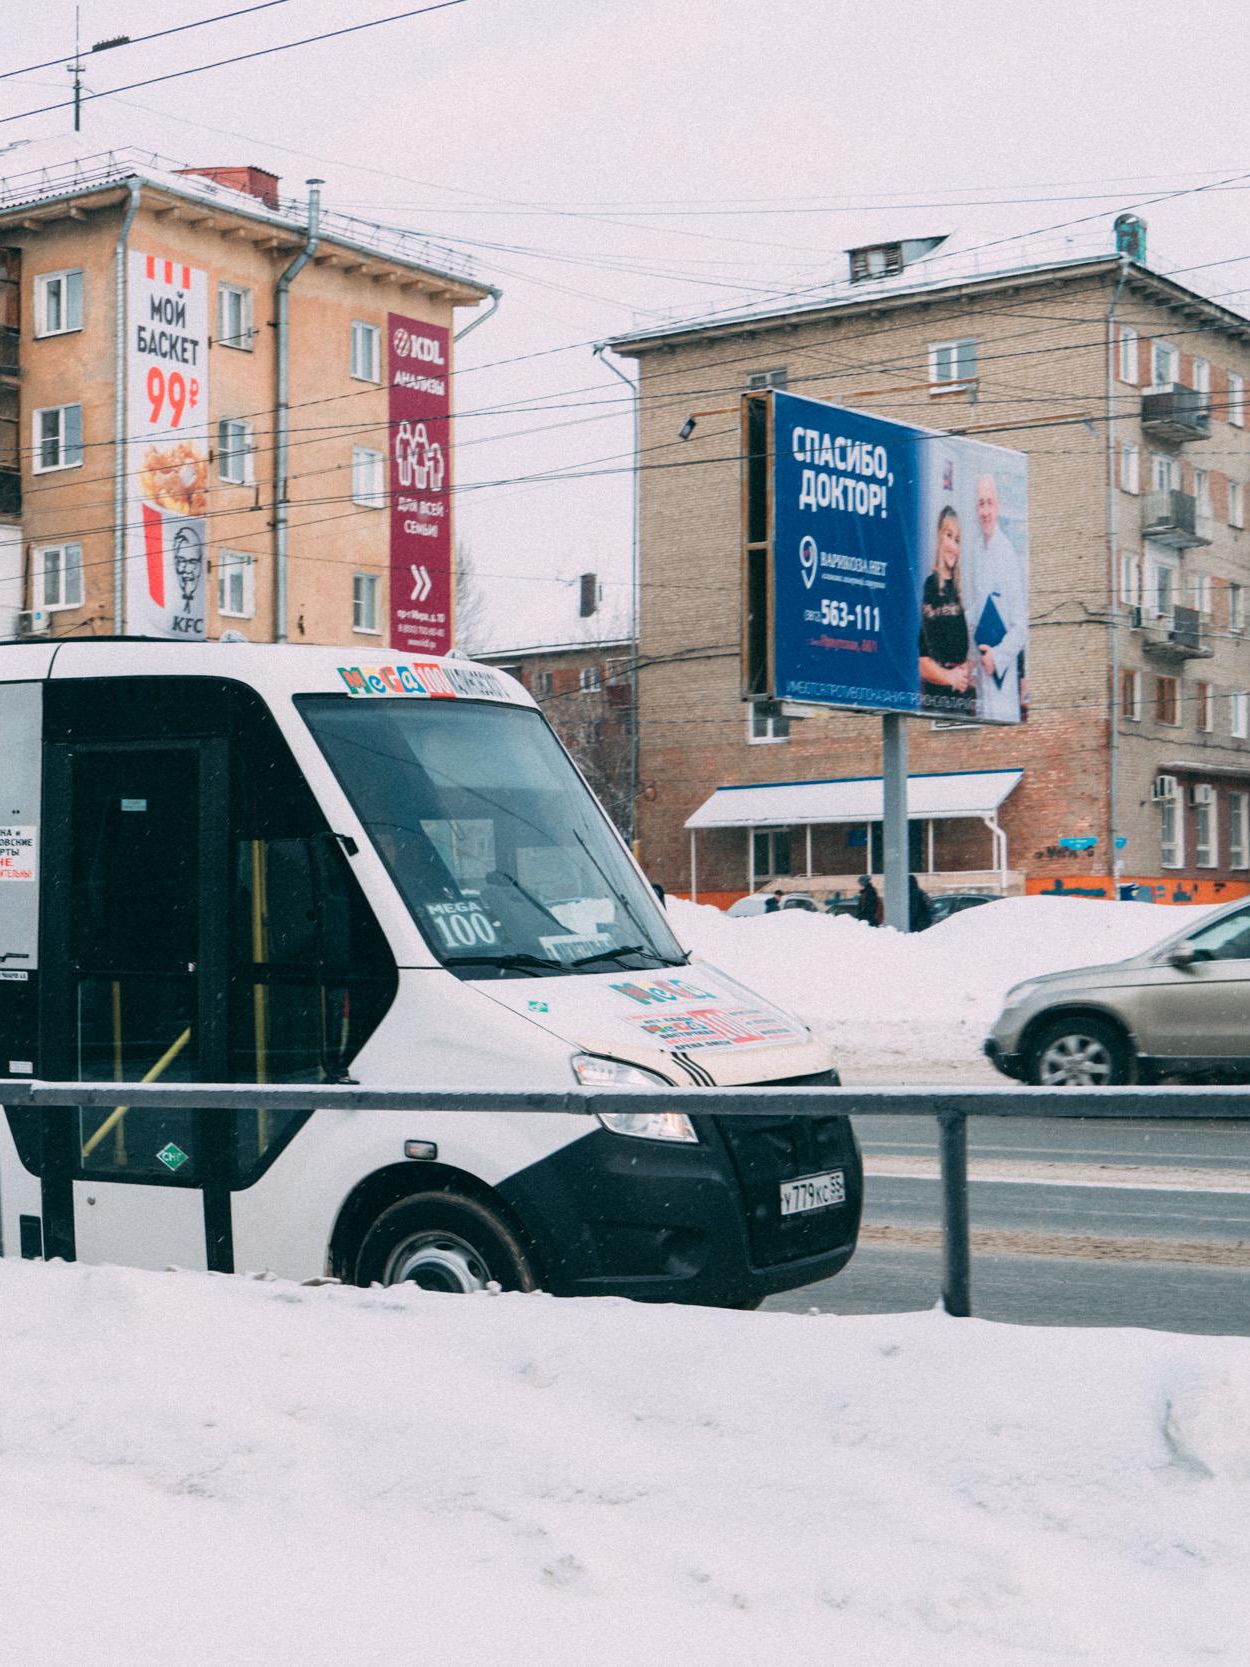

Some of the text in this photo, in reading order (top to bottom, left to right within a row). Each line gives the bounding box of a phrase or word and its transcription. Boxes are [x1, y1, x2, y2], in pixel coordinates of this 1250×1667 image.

[150, 291, 186, 329] МОЙ
[137, 325, 199, 366] БАСКЕТ
[410, 334, 445, 365] KDL
[394, 370, 445, 396] АНАЛИЗЫ
[792, 426, 894, 487] СПАСИБО,
[799, 469, 887, 519] ДОКТОР!
[172, 616, 204, 633] KFC
[821, 599, 879, 632] 563-111
[426, 901, 483, 915] MEGA
[434, 912, 497, 948] 100
[783, 1183, 829, 1212] У779КС
